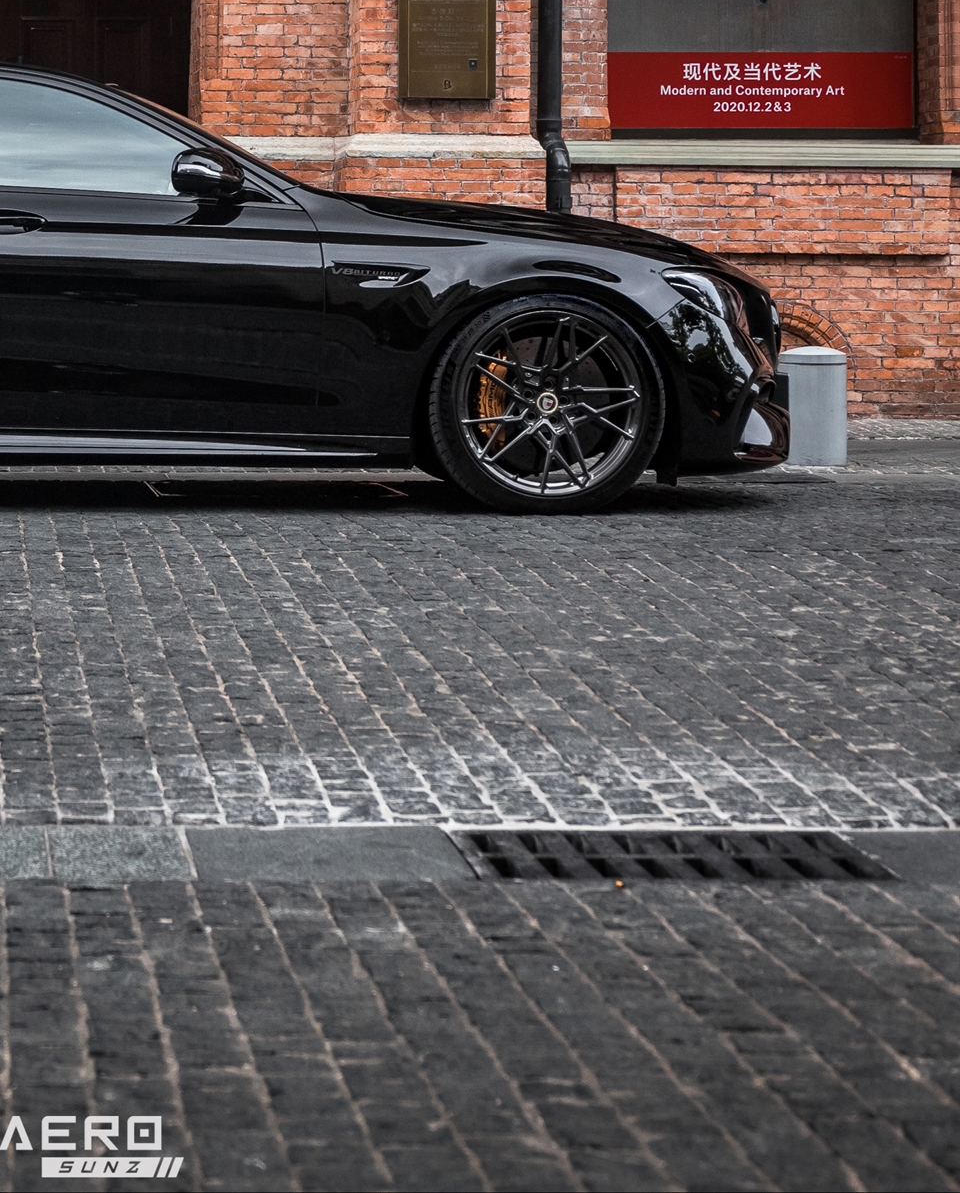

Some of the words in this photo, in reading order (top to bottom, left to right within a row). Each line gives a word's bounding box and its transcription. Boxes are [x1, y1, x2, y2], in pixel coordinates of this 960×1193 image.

[683, 62, 822, 81] 现代及当代艺术
[660, 85, 707, 96] Modern
[709, 85, 732, 96] and
[735, 85, 822, 98] Contemporary
[825, 85, 845, 96] Art
